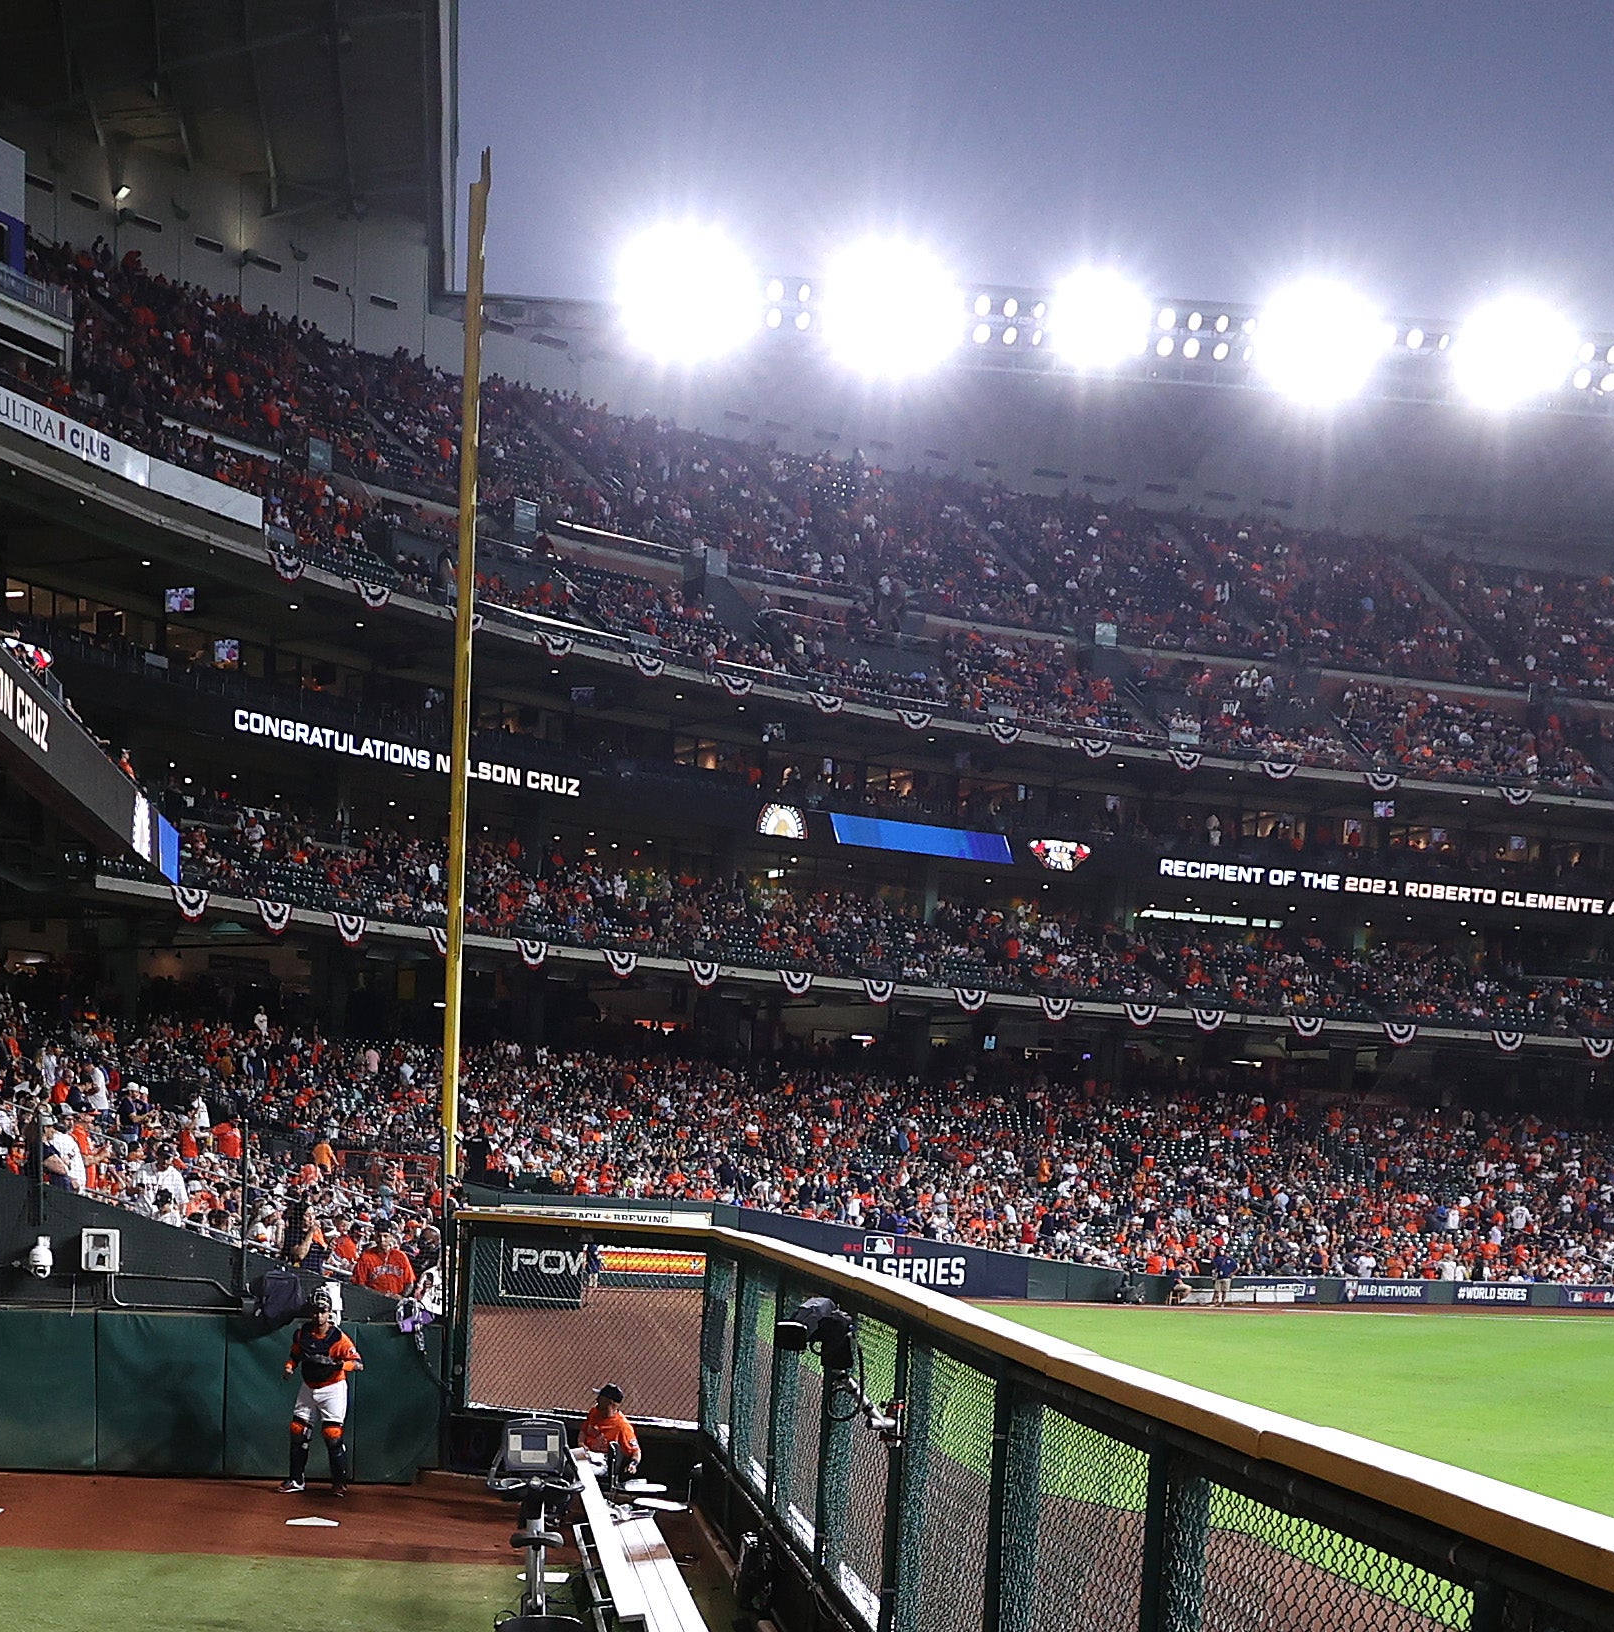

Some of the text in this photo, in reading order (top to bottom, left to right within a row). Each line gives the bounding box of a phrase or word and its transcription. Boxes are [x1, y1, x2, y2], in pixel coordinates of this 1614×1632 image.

[70, 428, 111, 463] CLUB
[16, 686, 49, 752] CRUZ
[234, 709, 580, 796] CONGRATULATIONS NLSON CRUZ
[1160, 859, 1265, 884] RECIPIENT
[1268, 870, 1296, 887] OF
[1301, 872, 1340, 891] THE
[1344, 876, 1399, 896] 2021
[1405, 881, 1496, 904] ROBERTO
[1501, 891, 1604, 914] CLEMENTE
[613, 1214, 670, 1224] BREWING
[882, 1256, 966, 1285] SERIES
[1357, 1285, 1423, 1297] MLB NETWORK
[1457, 1286, 1527, 1301] #WORLD SERIES
